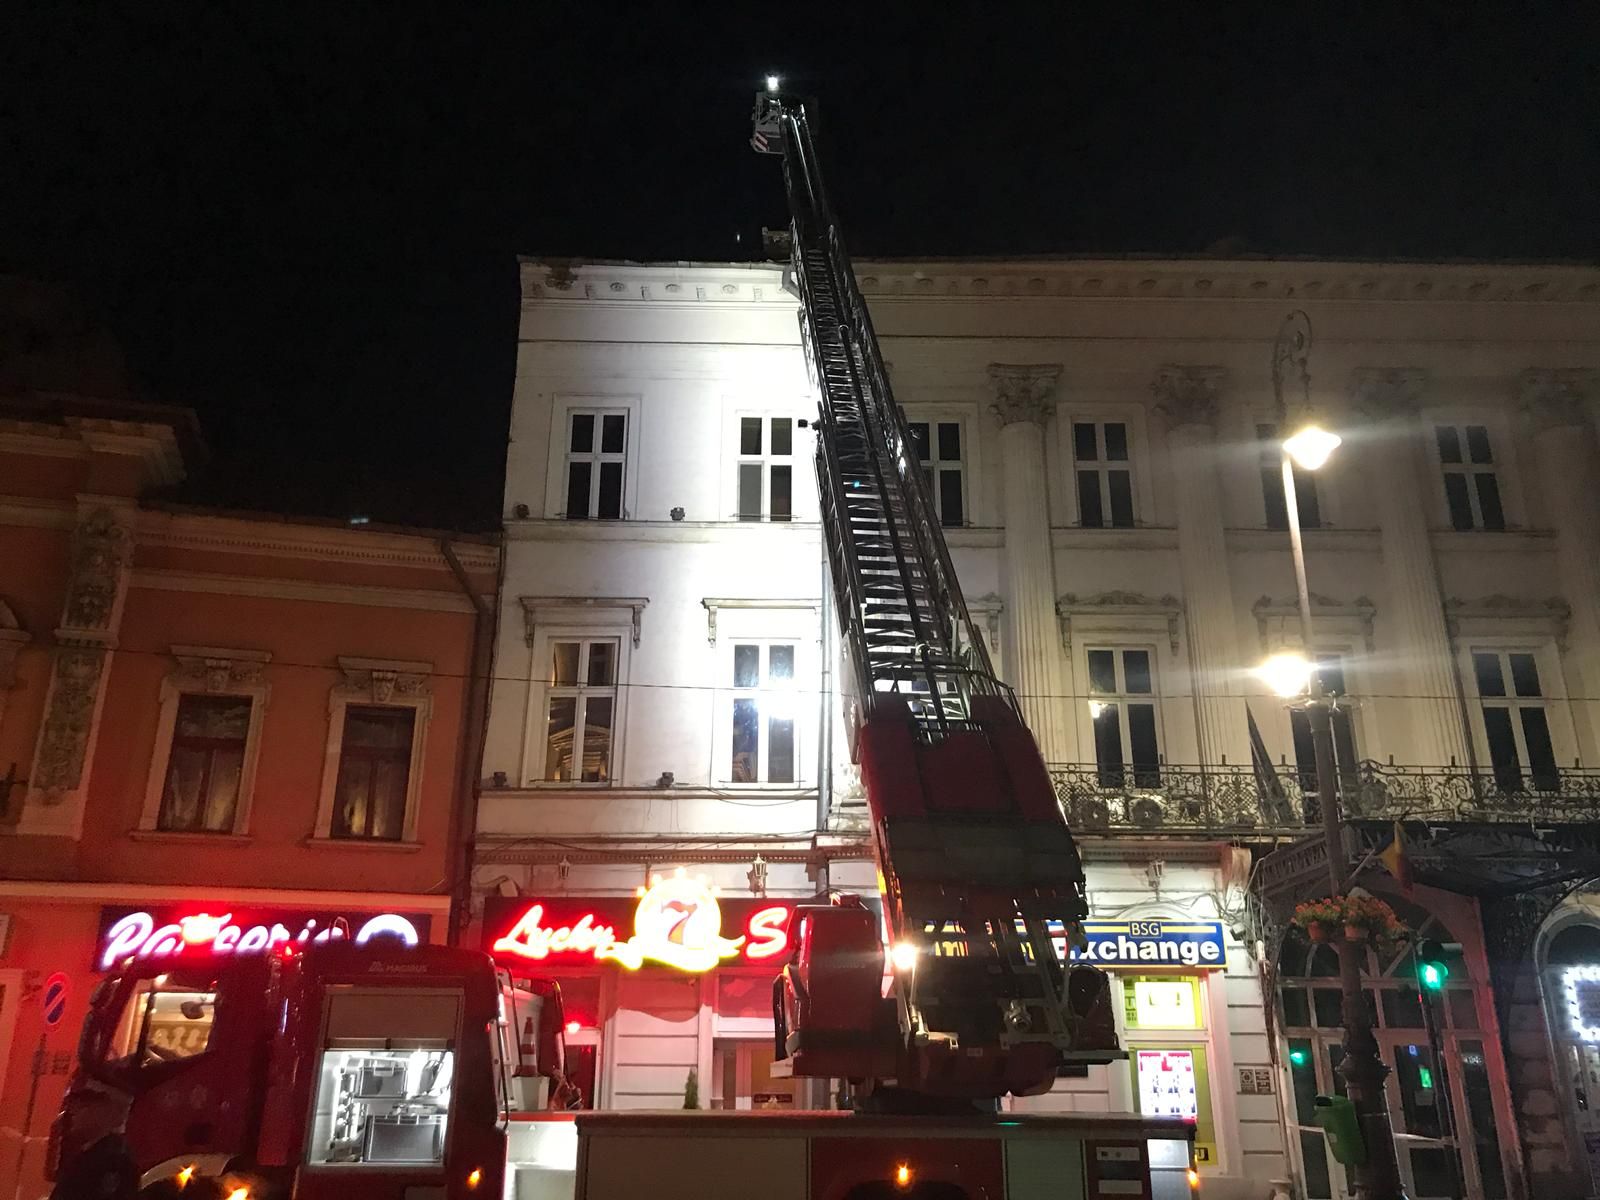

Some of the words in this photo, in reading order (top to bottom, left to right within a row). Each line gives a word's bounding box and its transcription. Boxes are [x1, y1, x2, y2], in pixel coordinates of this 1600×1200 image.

[494, 904, 616, 959] Lucky
[660, 900, 698, 946] 7
[1131, 922, 1160, 936] BSG
[1051, 935, 1220, 965] Exchange
